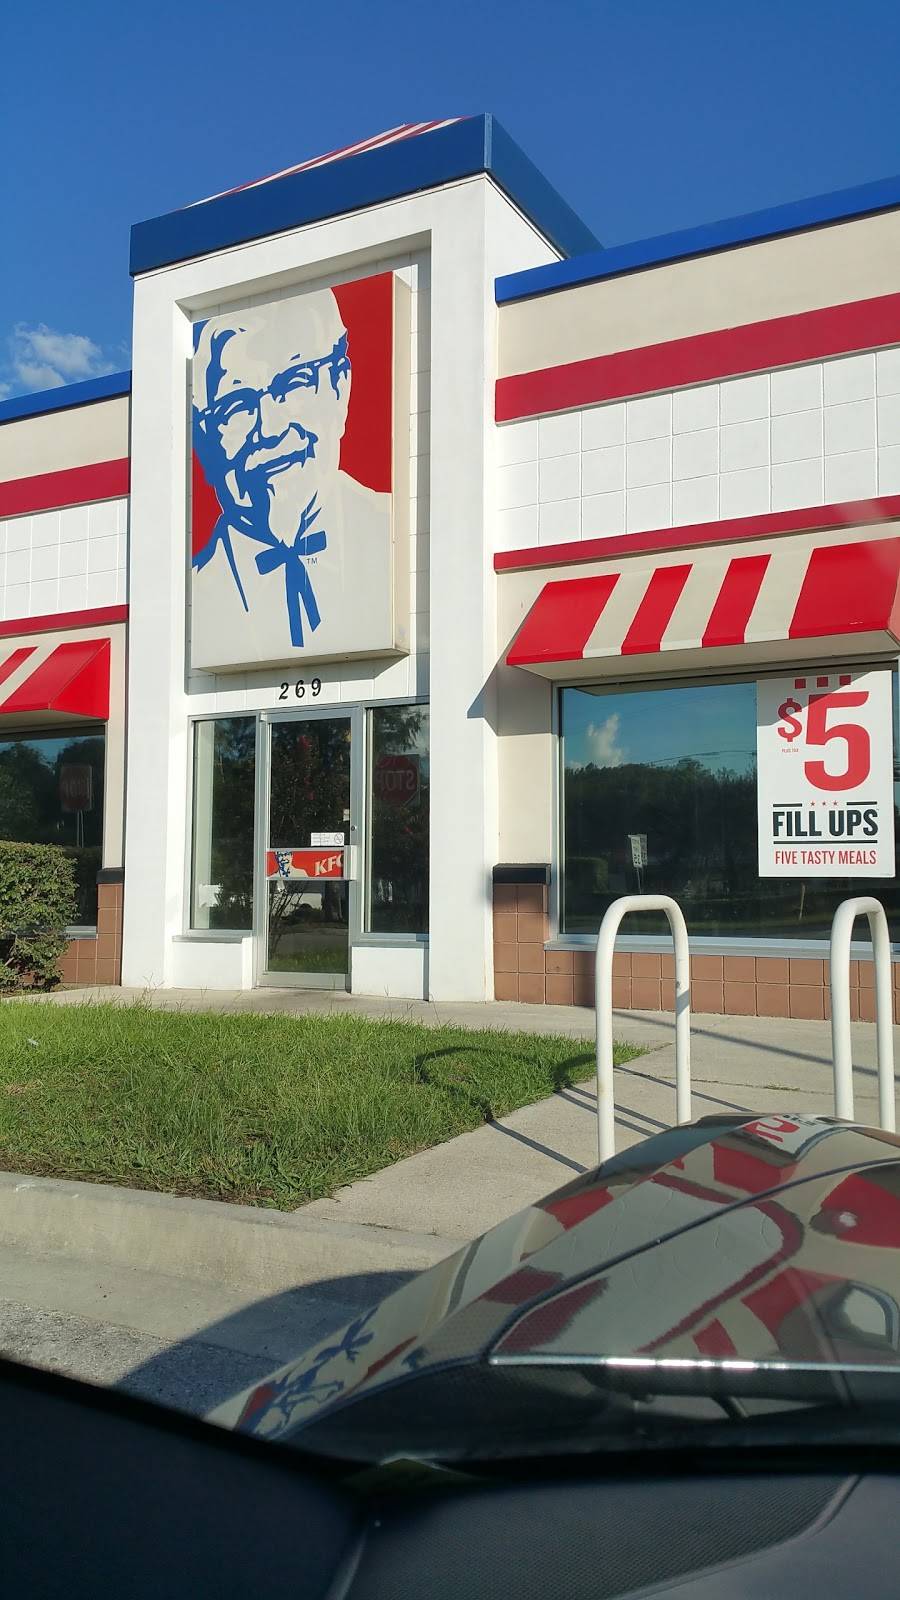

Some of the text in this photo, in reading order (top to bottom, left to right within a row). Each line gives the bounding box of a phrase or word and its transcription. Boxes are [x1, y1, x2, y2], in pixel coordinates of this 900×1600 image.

[278, 677, 323, 701] 269
[777, 690, 871, 792] $5
[772, 808, 879, 837] FILL UPS
[775, 850, 877, 865] FIVE TASTY MEALS
